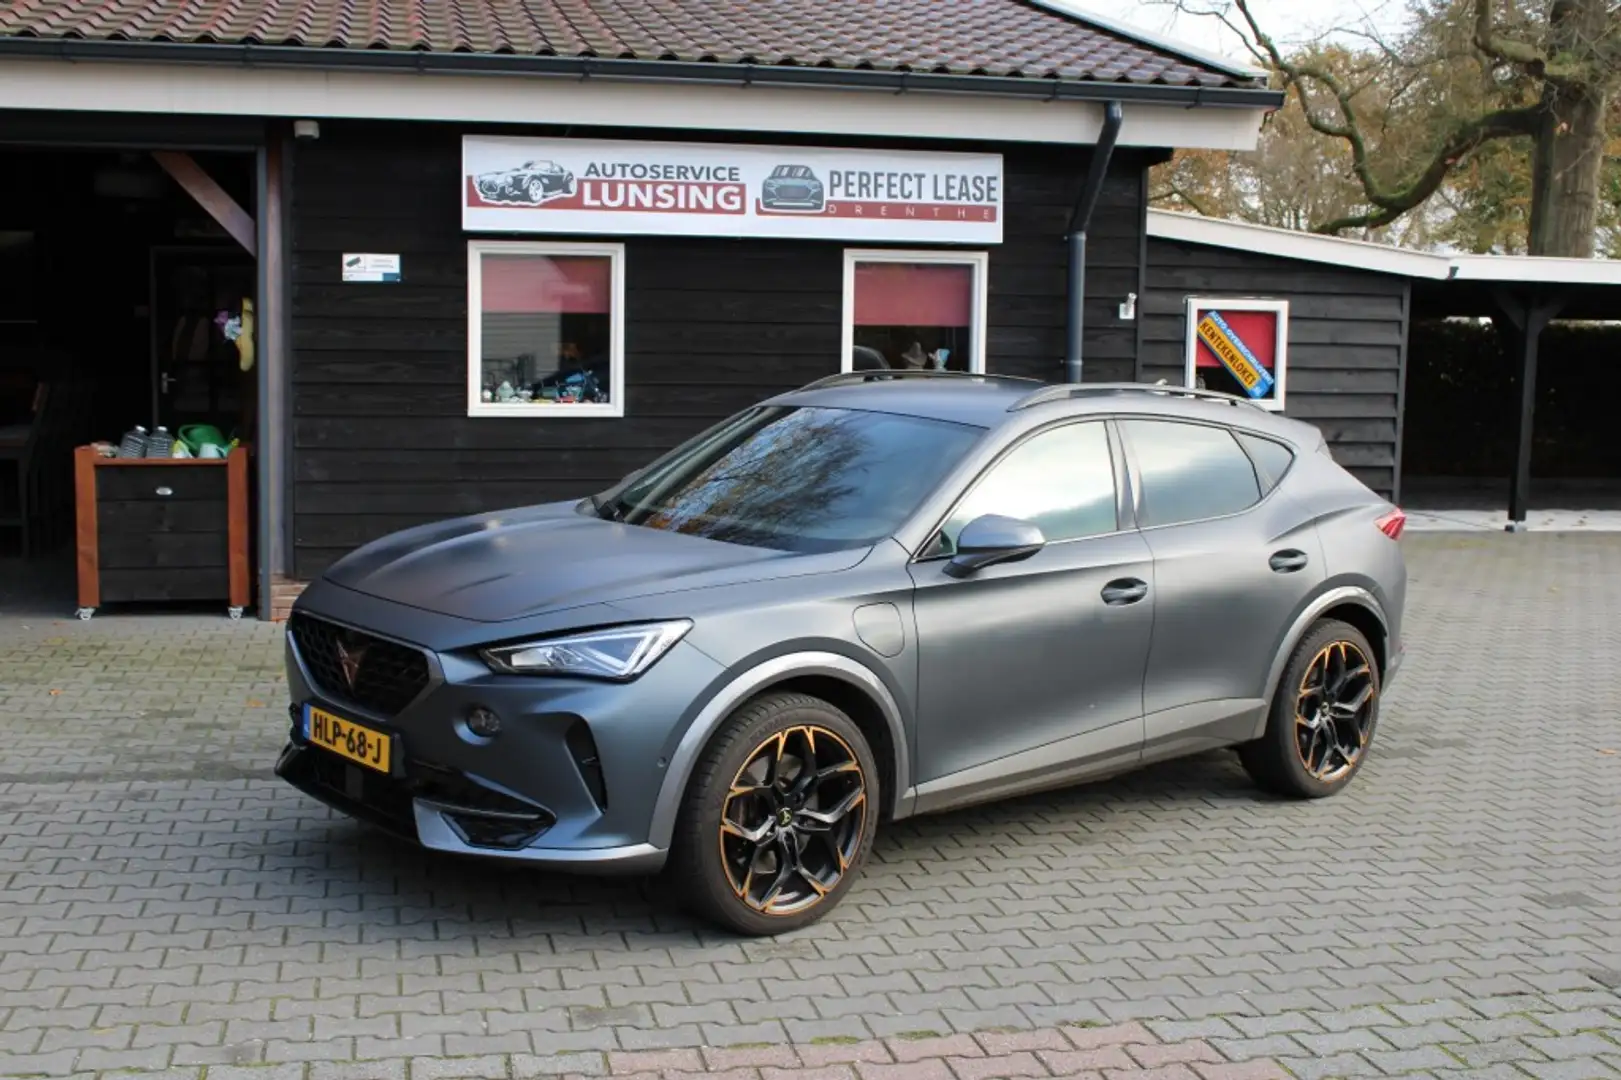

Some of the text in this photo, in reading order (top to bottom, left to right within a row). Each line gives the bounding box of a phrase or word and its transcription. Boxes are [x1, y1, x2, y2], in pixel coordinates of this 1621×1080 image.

[584, 161, 741, 182] AUTOSERVICE
[829, 169, 998, 203] PERFECT LEASE
[582, 181, 743, 211] LUNSING
[827, 203, 991, 221] DRENTHE
[1200, 321, 1257, 387] KENTEKENLOKET
[313, 711, 382, 765] HLP-68-J
